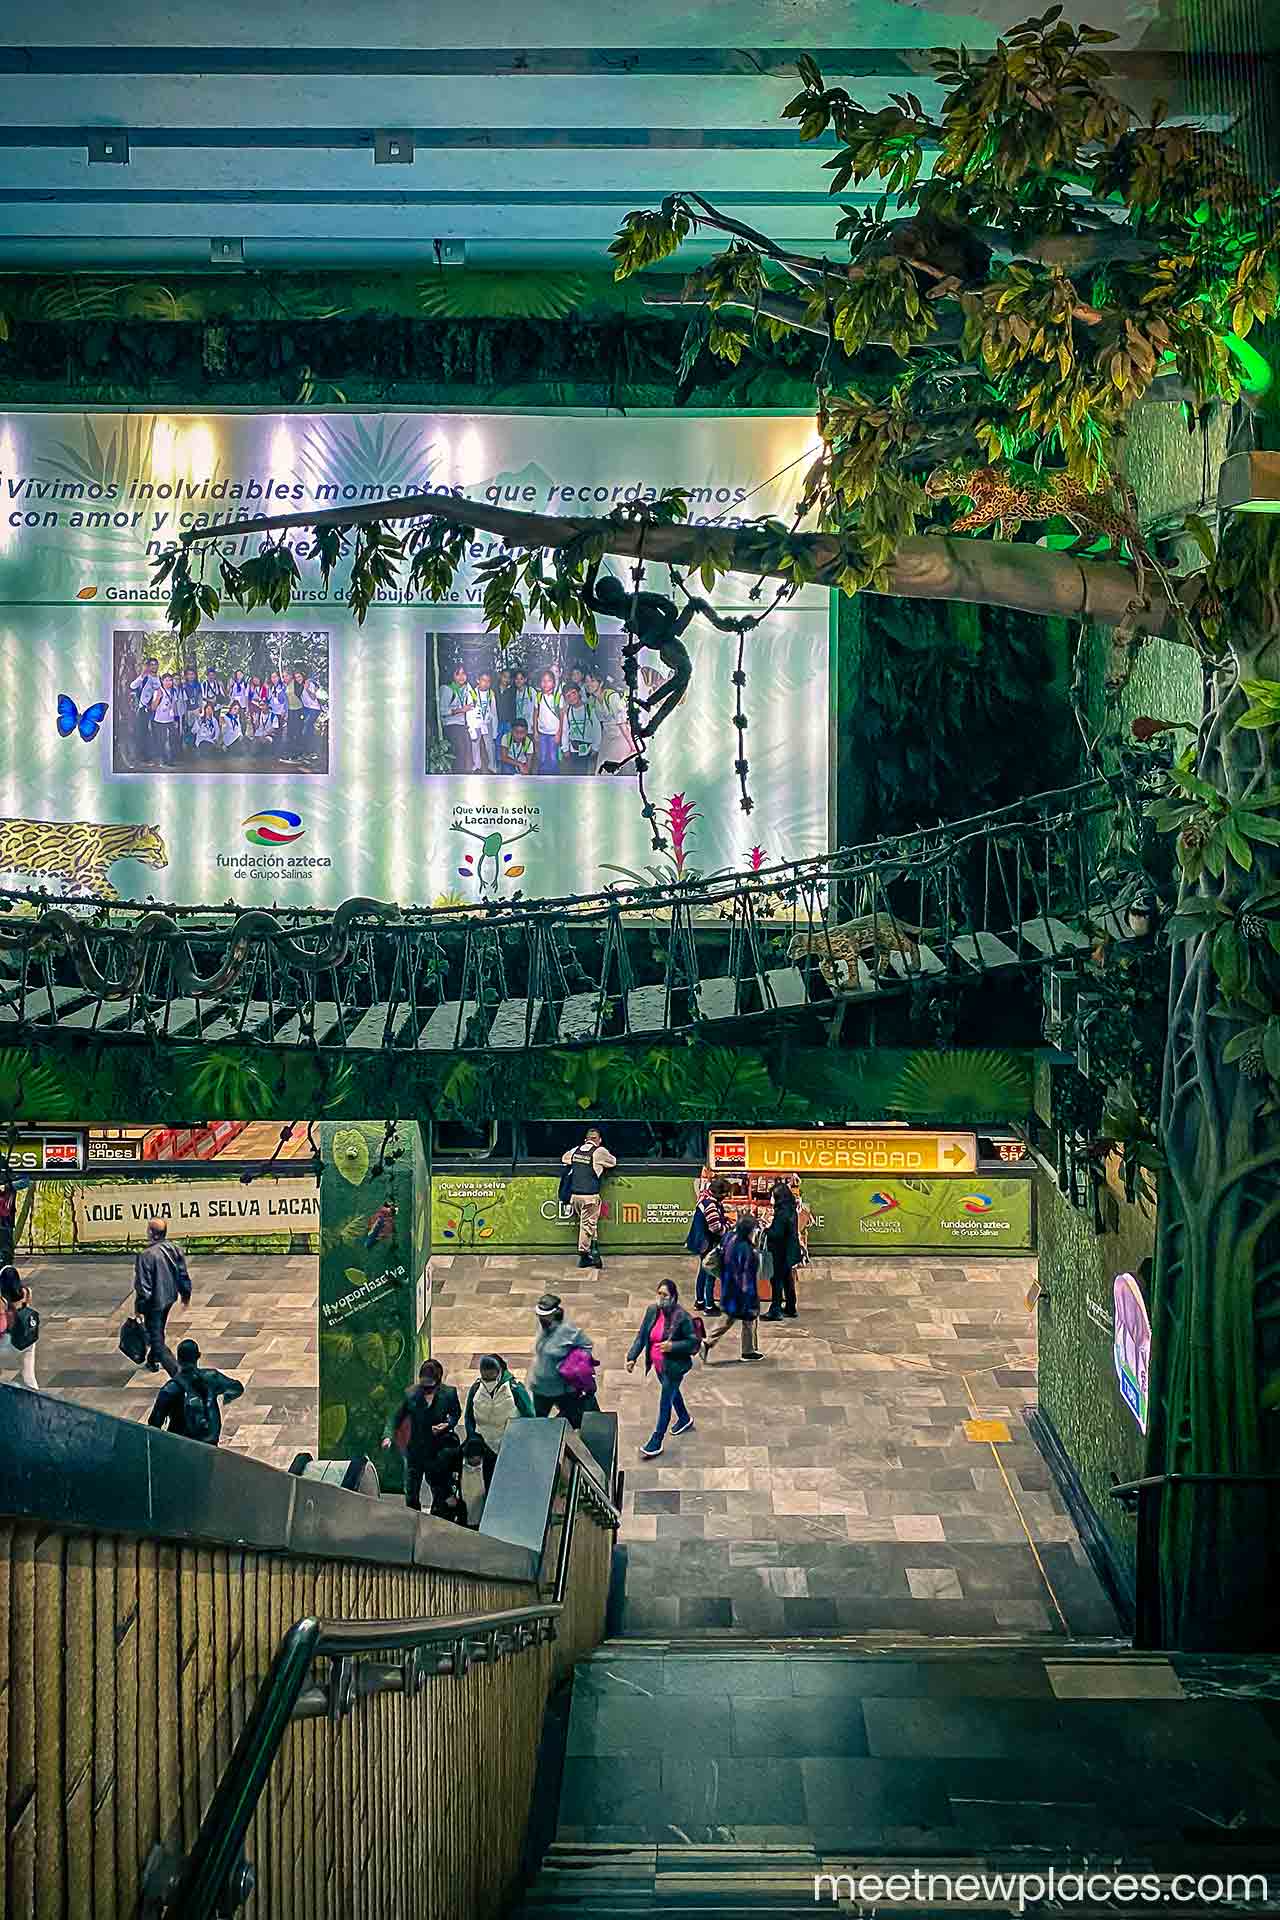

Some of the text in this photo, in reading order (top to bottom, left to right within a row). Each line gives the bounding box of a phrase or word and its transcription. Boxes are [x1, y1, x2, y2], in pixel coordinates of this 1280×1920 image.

[129, 478, 304, 500] inolvidables
[485, 484, 537, 506] que
[547, 482, 747, 503] recordarmos
[8, 511, 58, 528] con
[69, 511, 143, 528] amor
[151, 511, 170, 532] y
[145, 535, 249, 556] naural
[105, 585, 172, 601] Ganado
[377, 587, 414, 604] bujo
[475, 804, 499, 815] viva
[511, 804, 540, 815] selva
[216, 853, 332, 867] fundación azteca
[234, 868, 313, 881] de Grupo Salinas
[799, 1138, 887, 1150] DIRECCION
[763, 1149, 923, 1168] UNIVERSIDAD
[484, 1181, 506, 1190] selva
[84, 1203, 124, 1222] ¡QUE
[180, 1201, 201, 1219] LA
[208, 1199, 261, 1218] SELVA
[268, 1198, 320, 1216] LACAN
[647, 1216, 690, 1224] COLECTIVO
[940, 1219, 1010, 1229] fundación azteca
